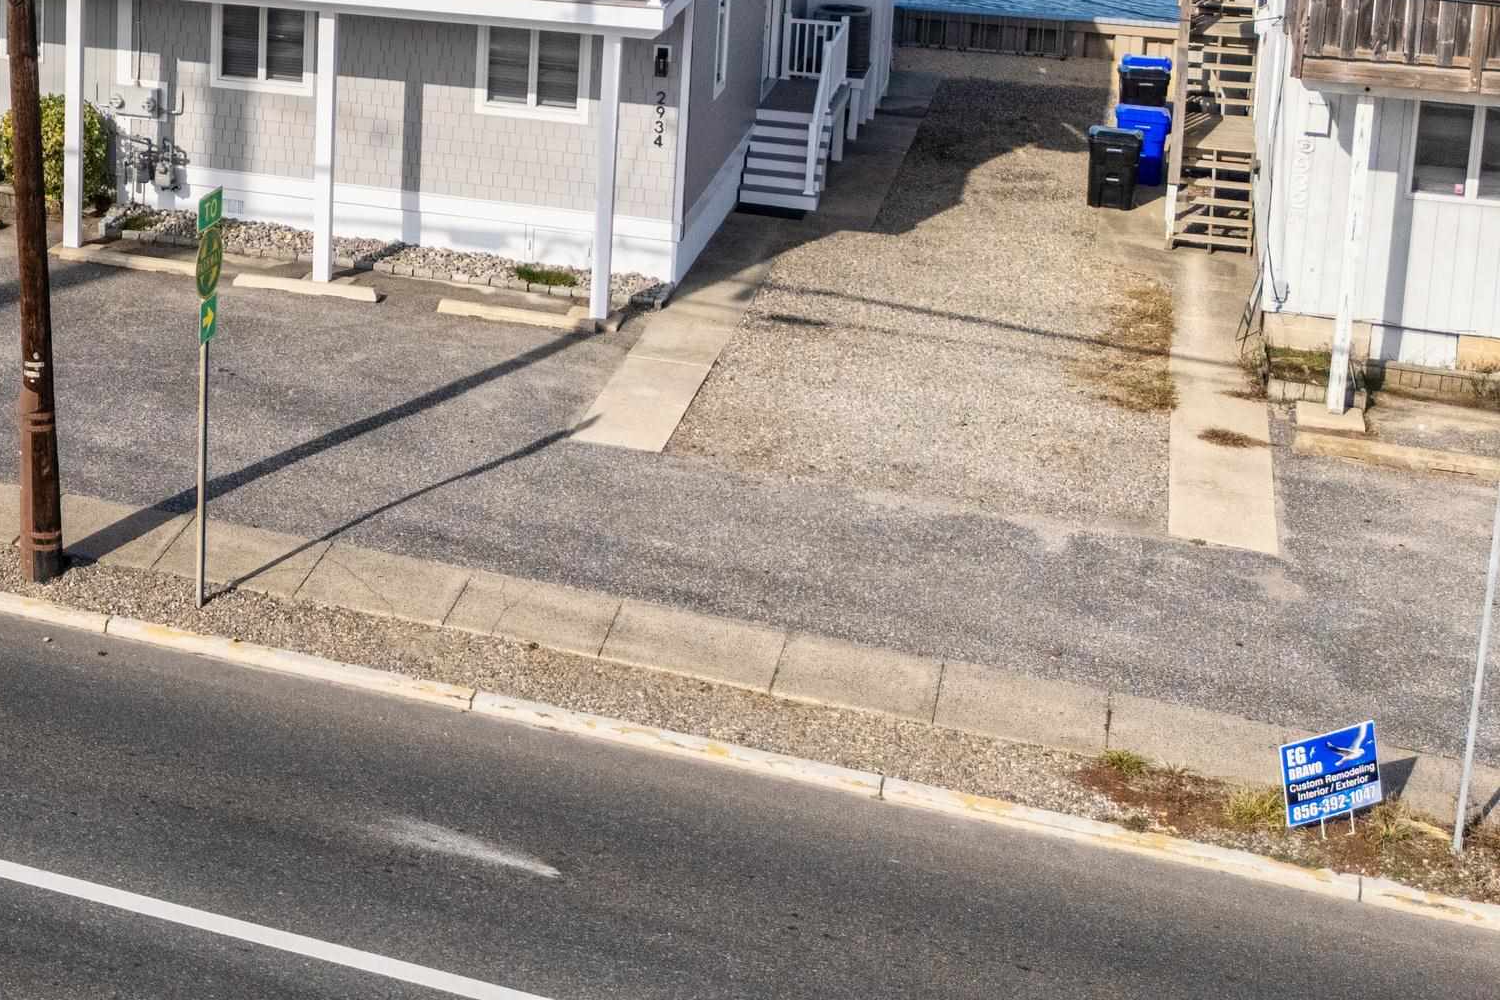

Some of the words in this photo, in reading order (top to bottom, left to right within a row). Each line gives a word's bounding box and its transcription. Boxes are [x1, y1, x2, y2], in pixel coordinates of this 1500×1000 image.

[653, 91, 666, 148] 2934
[204, 199, 218, 222] TO
[1286, 747, 1307, 768] EG
[1289, 778, 1324, 793] Custom
[1325, 763, 1375, 783] Remodeling
[1297, 787, 1330, 801] Interior
[1335, 775, 1369, 790] Exterior
[1293, 785, 1376, 821] 856-392-1047
